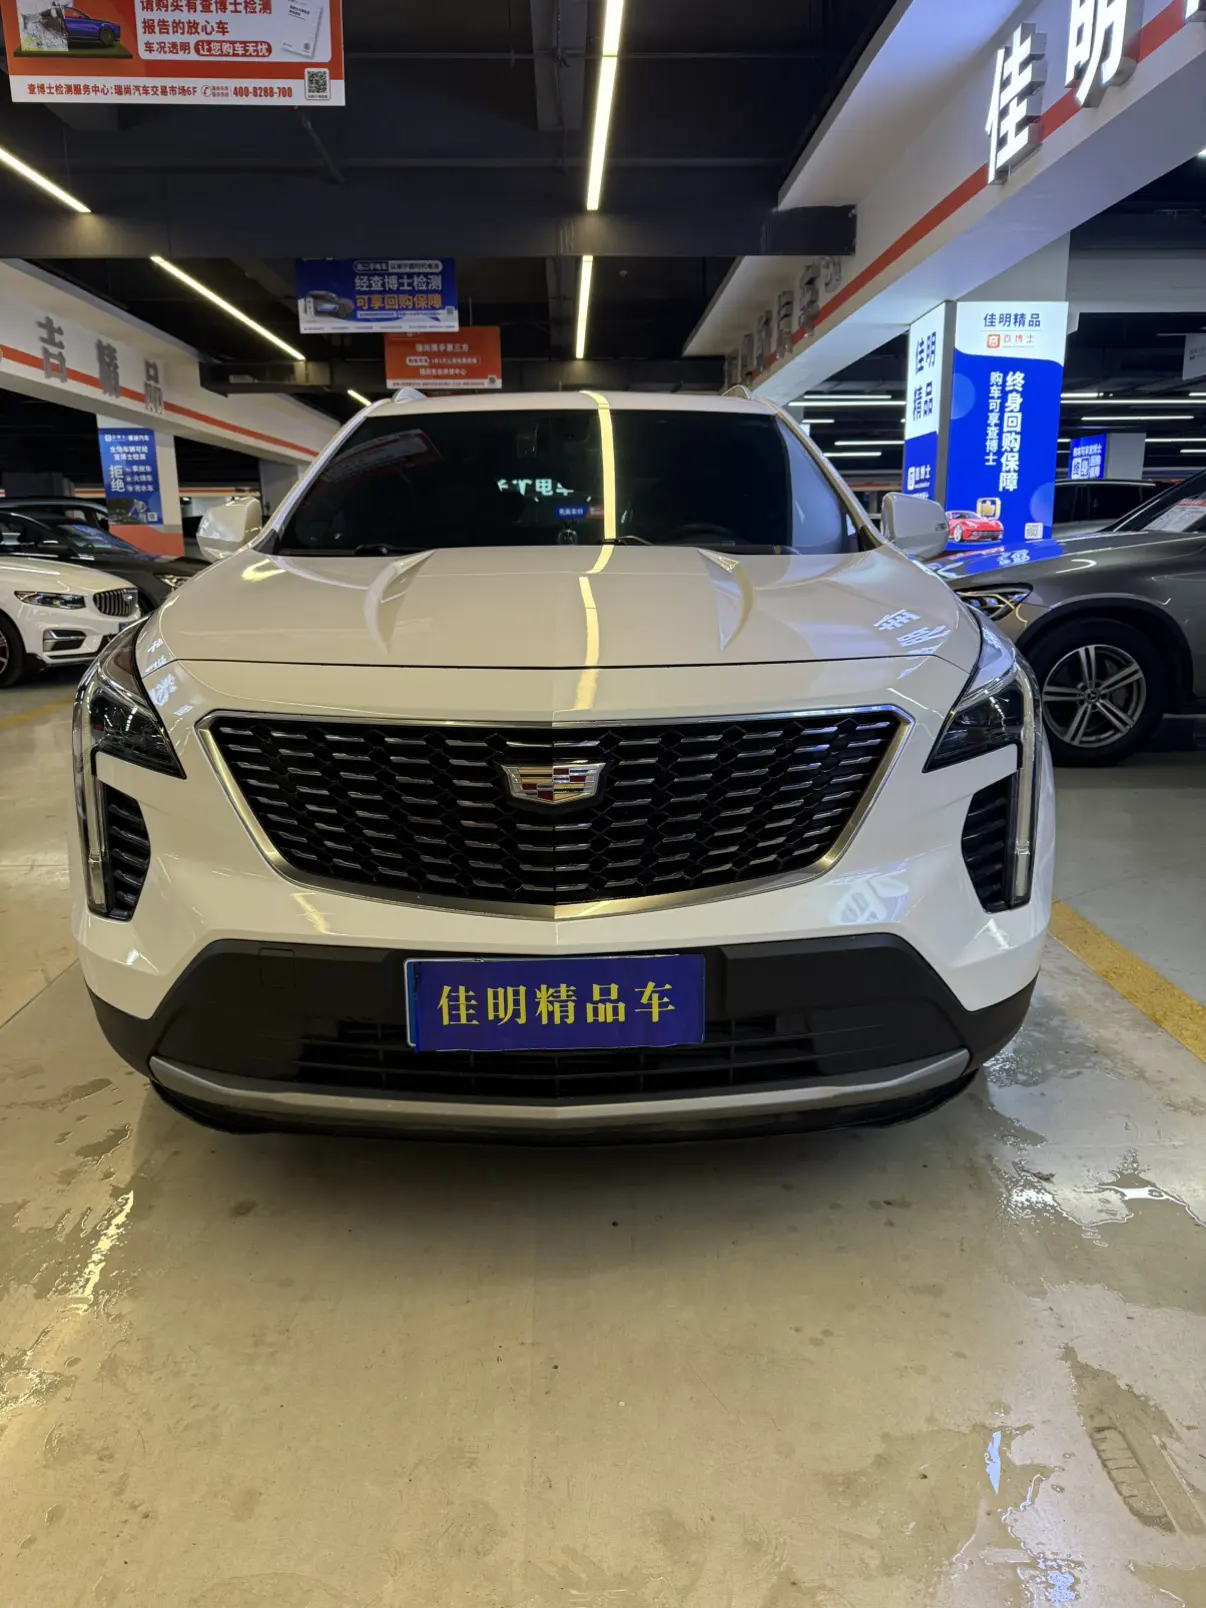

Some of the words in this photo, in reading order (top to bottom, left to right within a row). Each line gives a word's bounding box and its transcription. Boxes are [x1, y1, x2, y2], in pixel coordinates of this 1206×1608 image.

[140, 0, 272, 14] 请购买有查博士检测
[142, 18, 229, 36] 报告的放心车
[143, 40, 191, 54] 车况透明
[198, 42, 269, 56] 让您购车无忧
[233, 86, 293, 98] 400-8288-700
[354, 275, 442, 291] 经查博士检测
[355, 293, 442, 310] 可享回购保障
[984, 312, 1041, 328] 佳明精品
[985, 371, 1003, 466] 购车可享查博士
[999, 371, 1025, 493] 终身回购保障
[109, 465, 126, 493] 拒绝
[437, 981, 676, 1026] 佳明精品车
